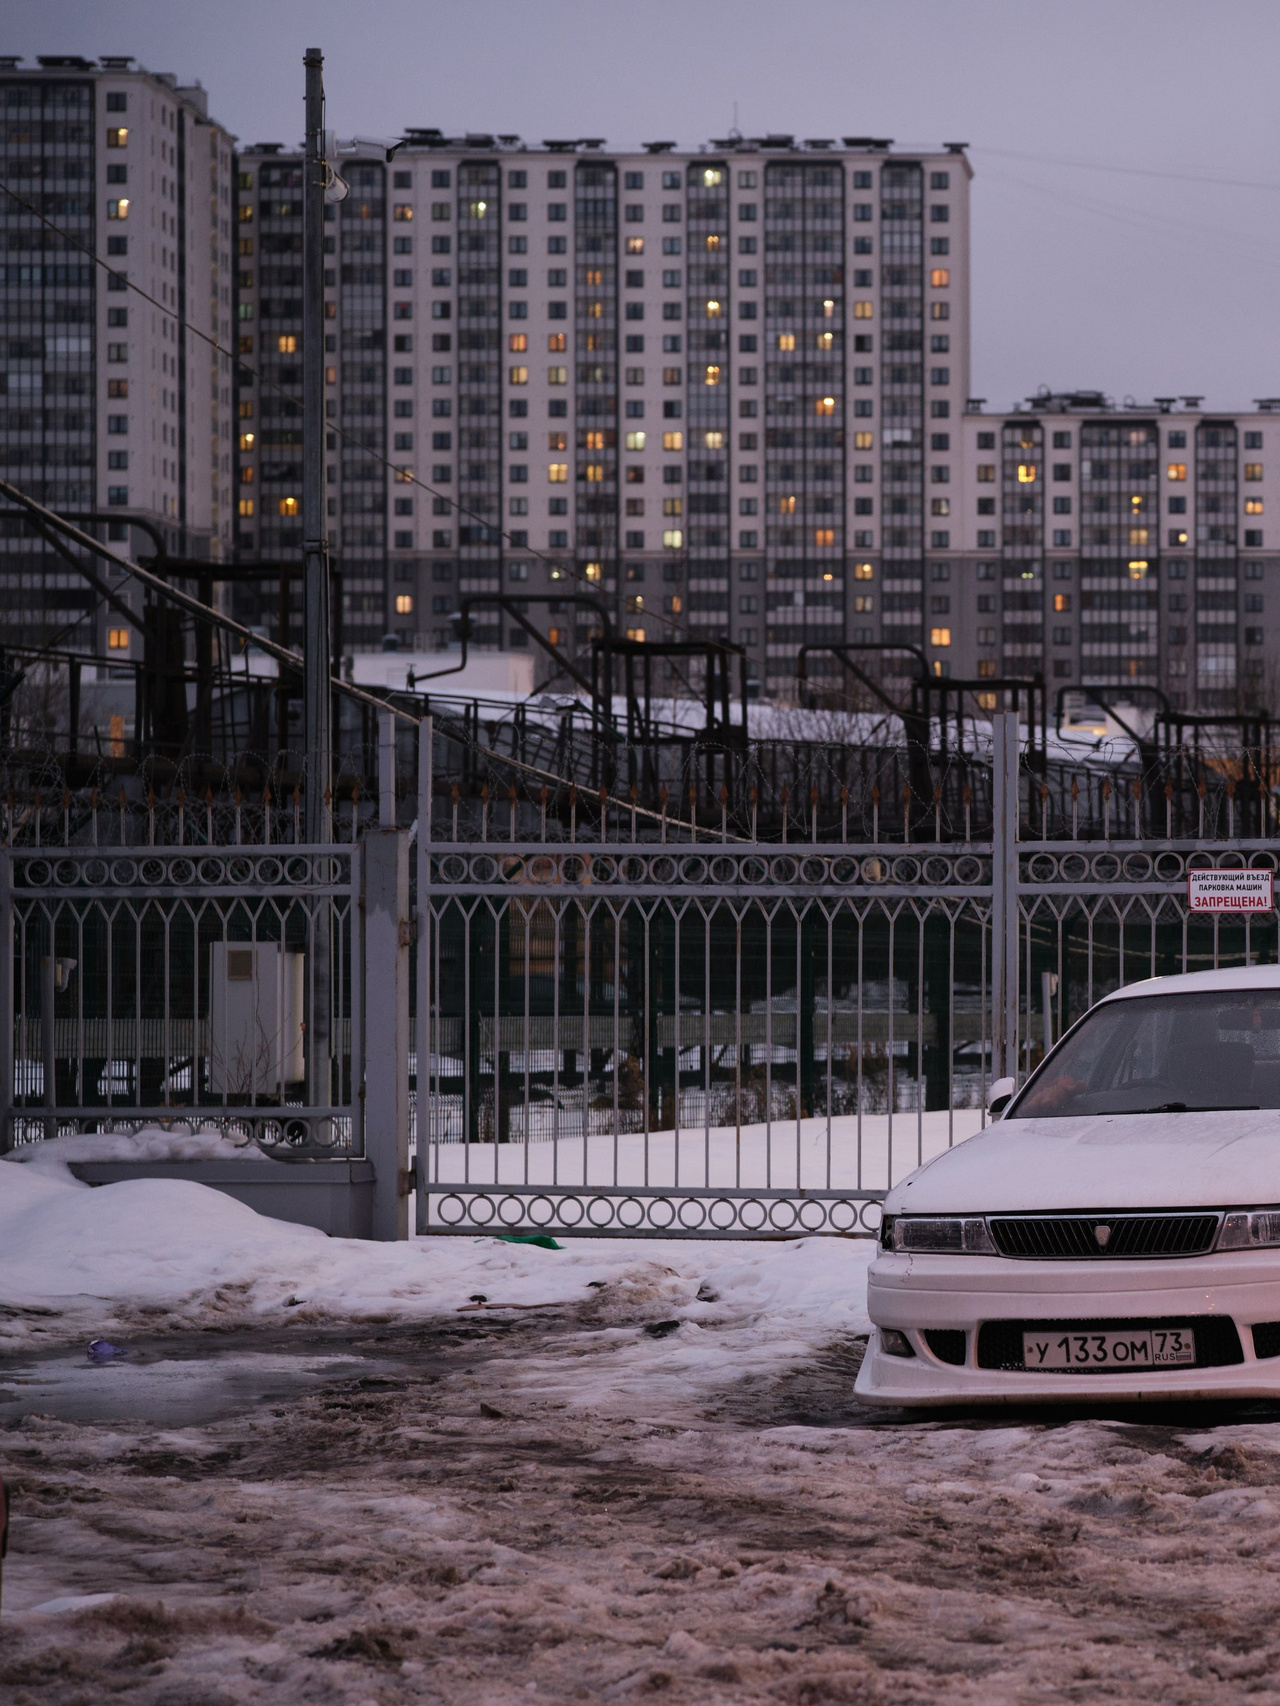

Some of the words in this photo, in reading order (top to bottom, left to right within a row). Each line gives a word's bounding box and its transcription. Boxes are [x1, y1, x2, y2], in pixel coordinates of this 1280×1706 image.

[1192, 873, 1245, 882] ДЕЙСТВУЮЩИЙ
[1246, 874, 1270, 882] ВЪЕЗД
[1194, 896, 1267, 909] ЗАПРЕЩЕНА!
[1154, 1332, 1183, 1353] 73
[1155, 1352, 1176, 1361] RUS
